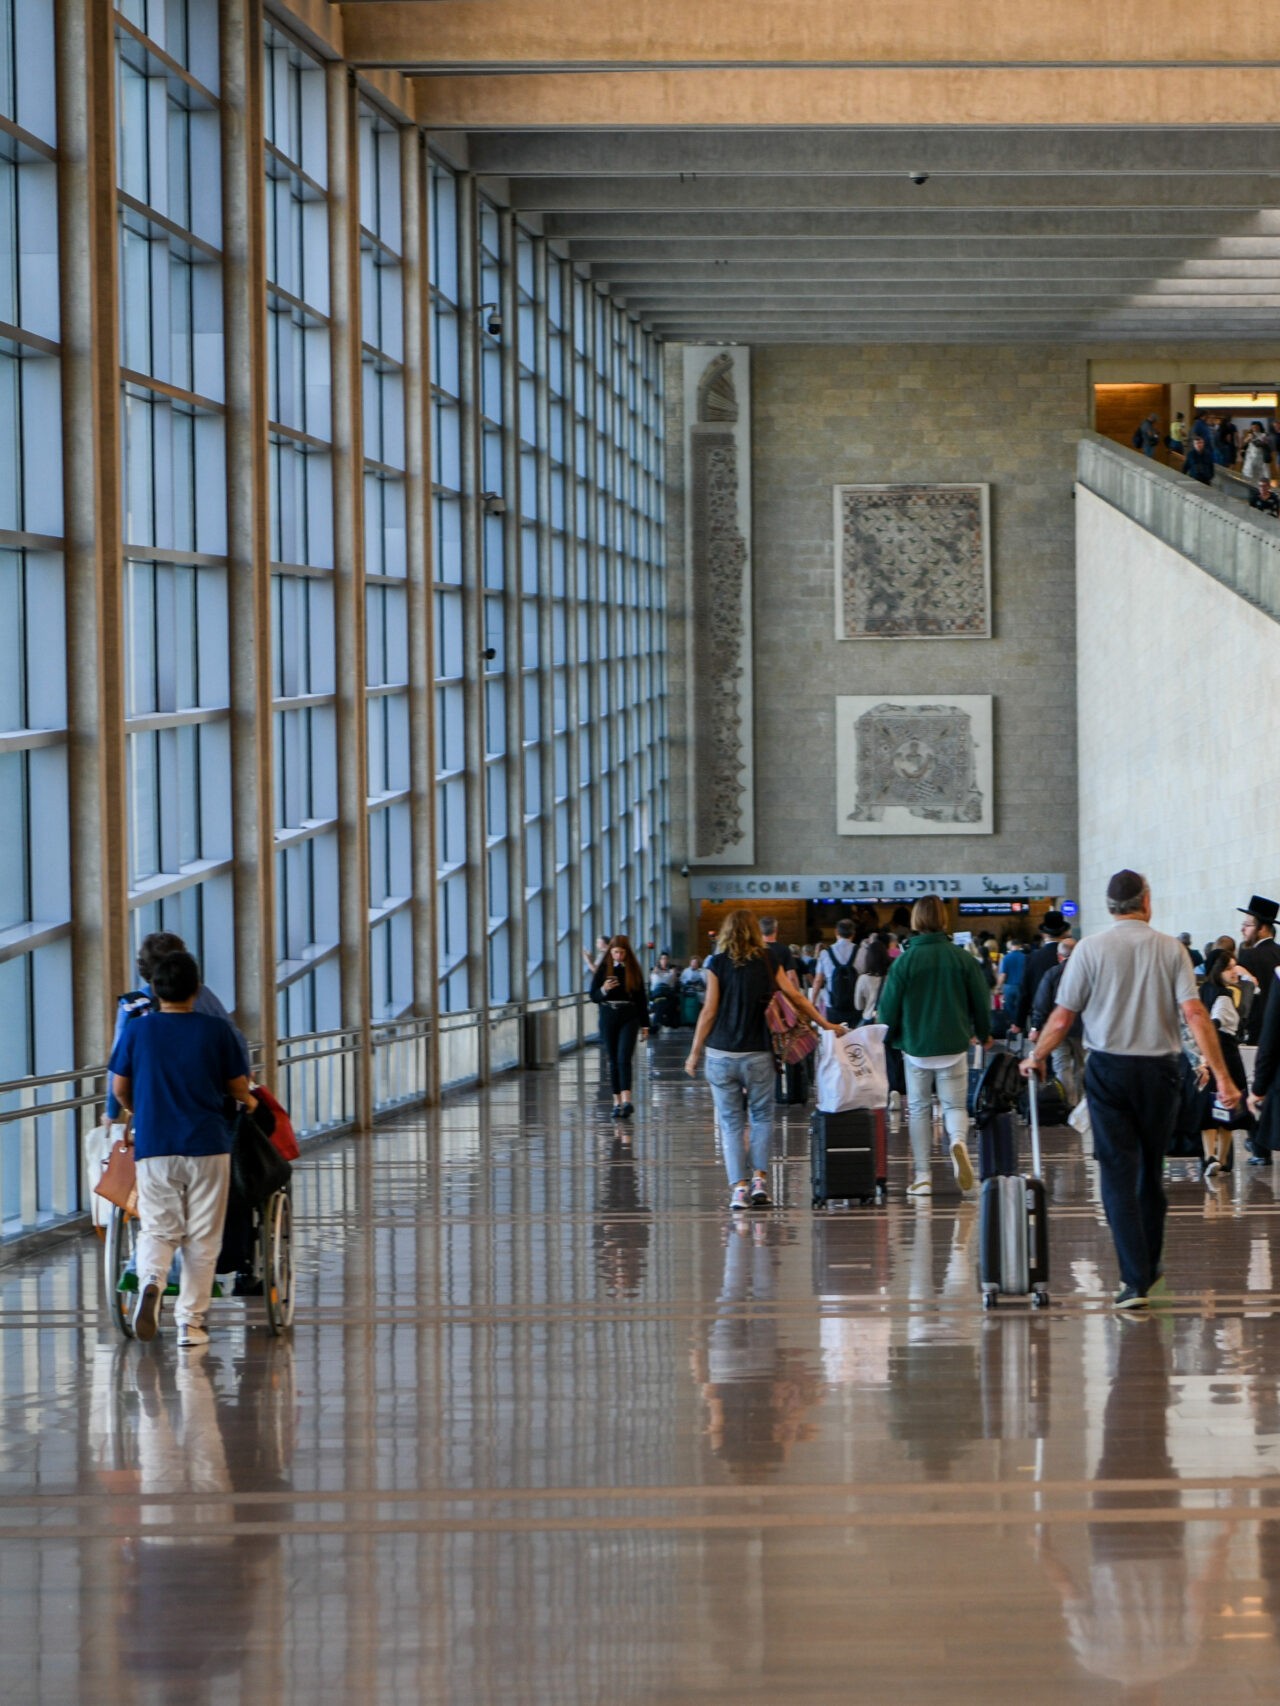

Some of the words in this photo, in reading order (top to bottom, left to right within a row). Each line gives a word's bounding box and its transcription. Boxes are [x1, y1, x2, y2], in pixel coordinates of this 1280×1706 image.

[708, 880, 800, 894] WELCOME
[818, 879, 885, 893] הבאים
[893, 879, 961, 892] ברוכים
